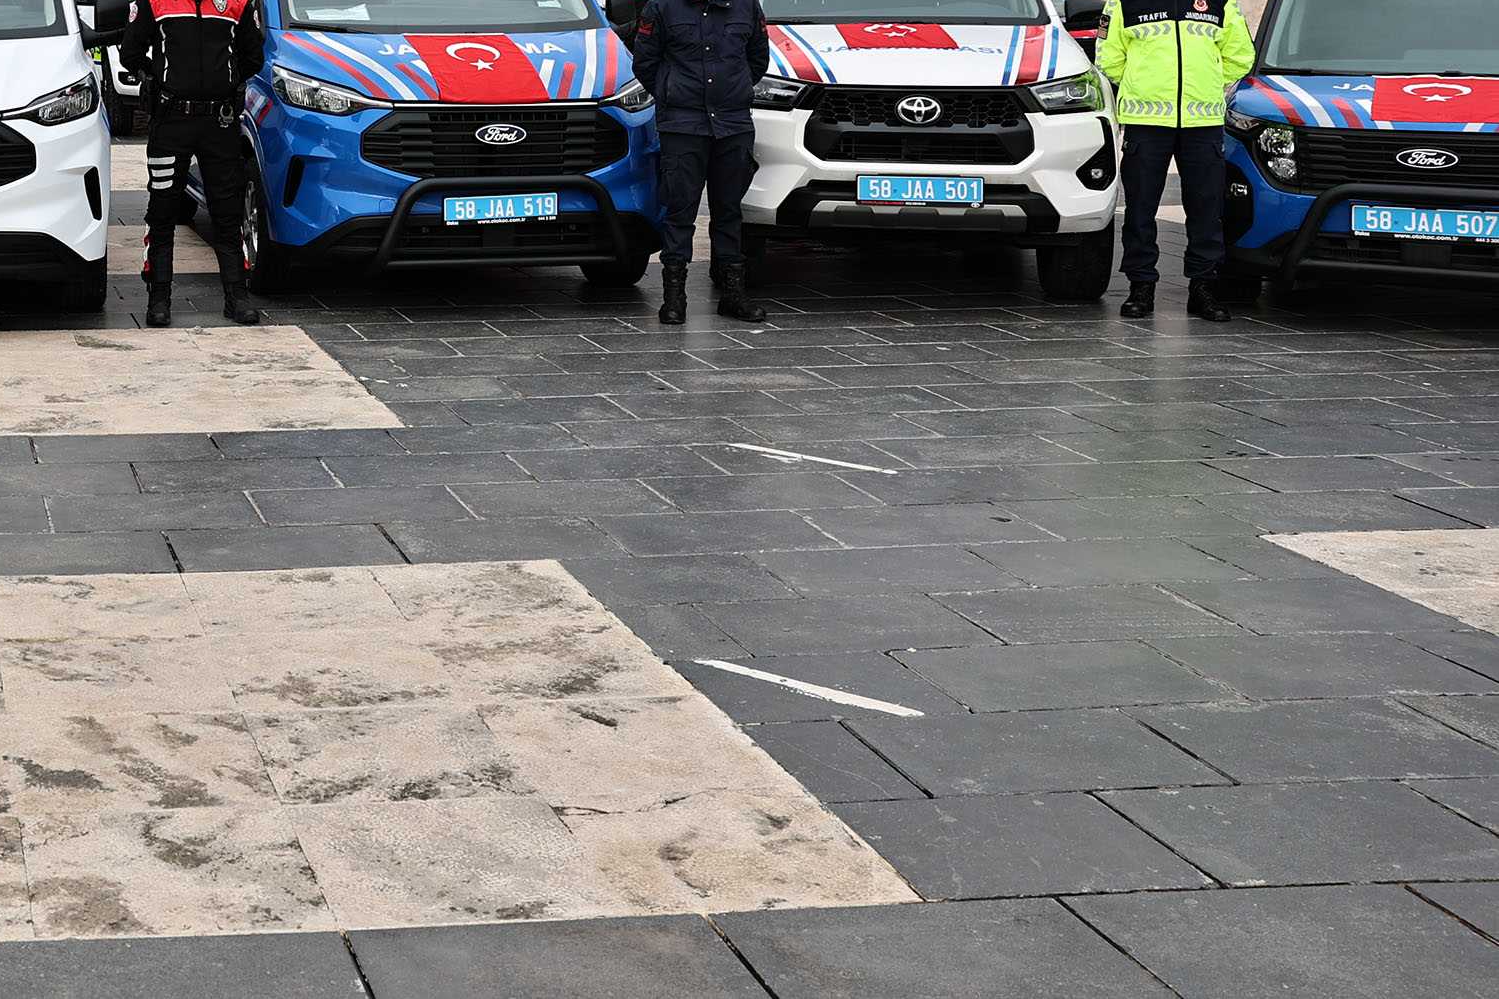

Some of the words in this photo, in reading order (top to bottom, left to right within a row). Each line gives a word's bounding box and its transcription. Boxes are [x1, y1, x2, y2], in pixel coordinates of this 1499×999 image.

[484, 126, 518, 141] Ford
[1407, 151, 1447, 166] Ford
[869, 179, 892, 198] 58
[901, 180, 935, 199] JAA
[945, 180, 979, 200] 501
[455, 200, 476, 219] 58
[484, 198, 515, 218] JAA
[524, 196, 554, 216] 519
[1365, 209, 1392, 230] 58
[1403, 211, 1444, 233] JAA
[1456, 214, 1498, 236] 507
